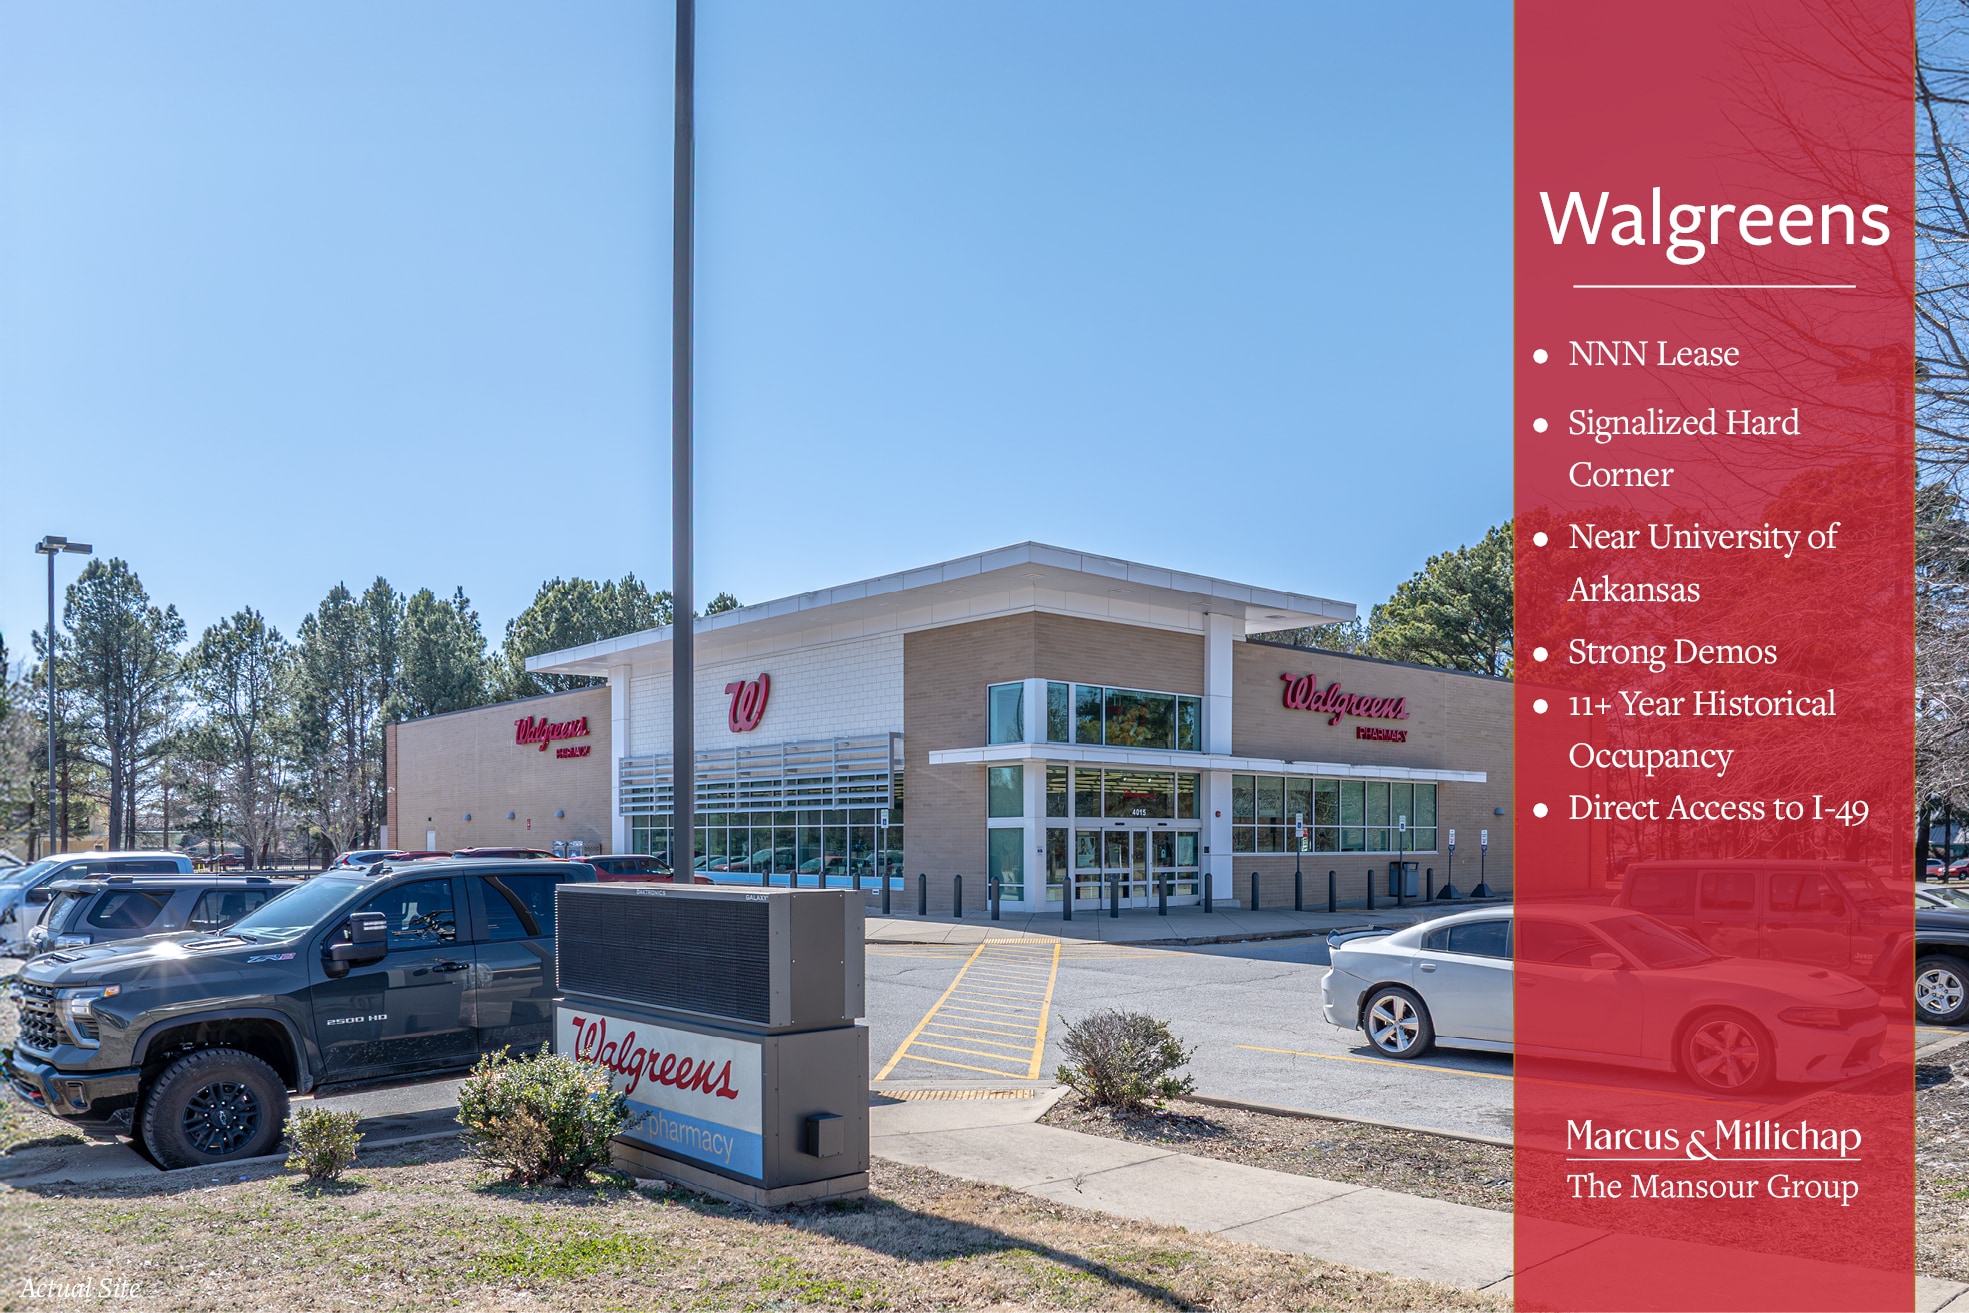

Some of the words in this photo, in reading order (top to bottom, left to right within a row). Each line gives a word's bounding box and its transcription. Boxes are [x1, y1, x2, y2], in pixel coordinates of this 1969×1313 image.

[724, 672, 770, 733] W
[1280, 673, 1410, 726] Walgreens
[514, 715, 590, 752] Walgreens
[1356, 726, 1408, 743] PHARMACY
[1131, 808, 1147, 816] 4015
[327, 1016, 364, 1026] 2500
[368, 1014, 387, 1022] HD
[572, 1016, 739, 1100] Walgreens
[647, 1111, 734, 1164] pharmacy
